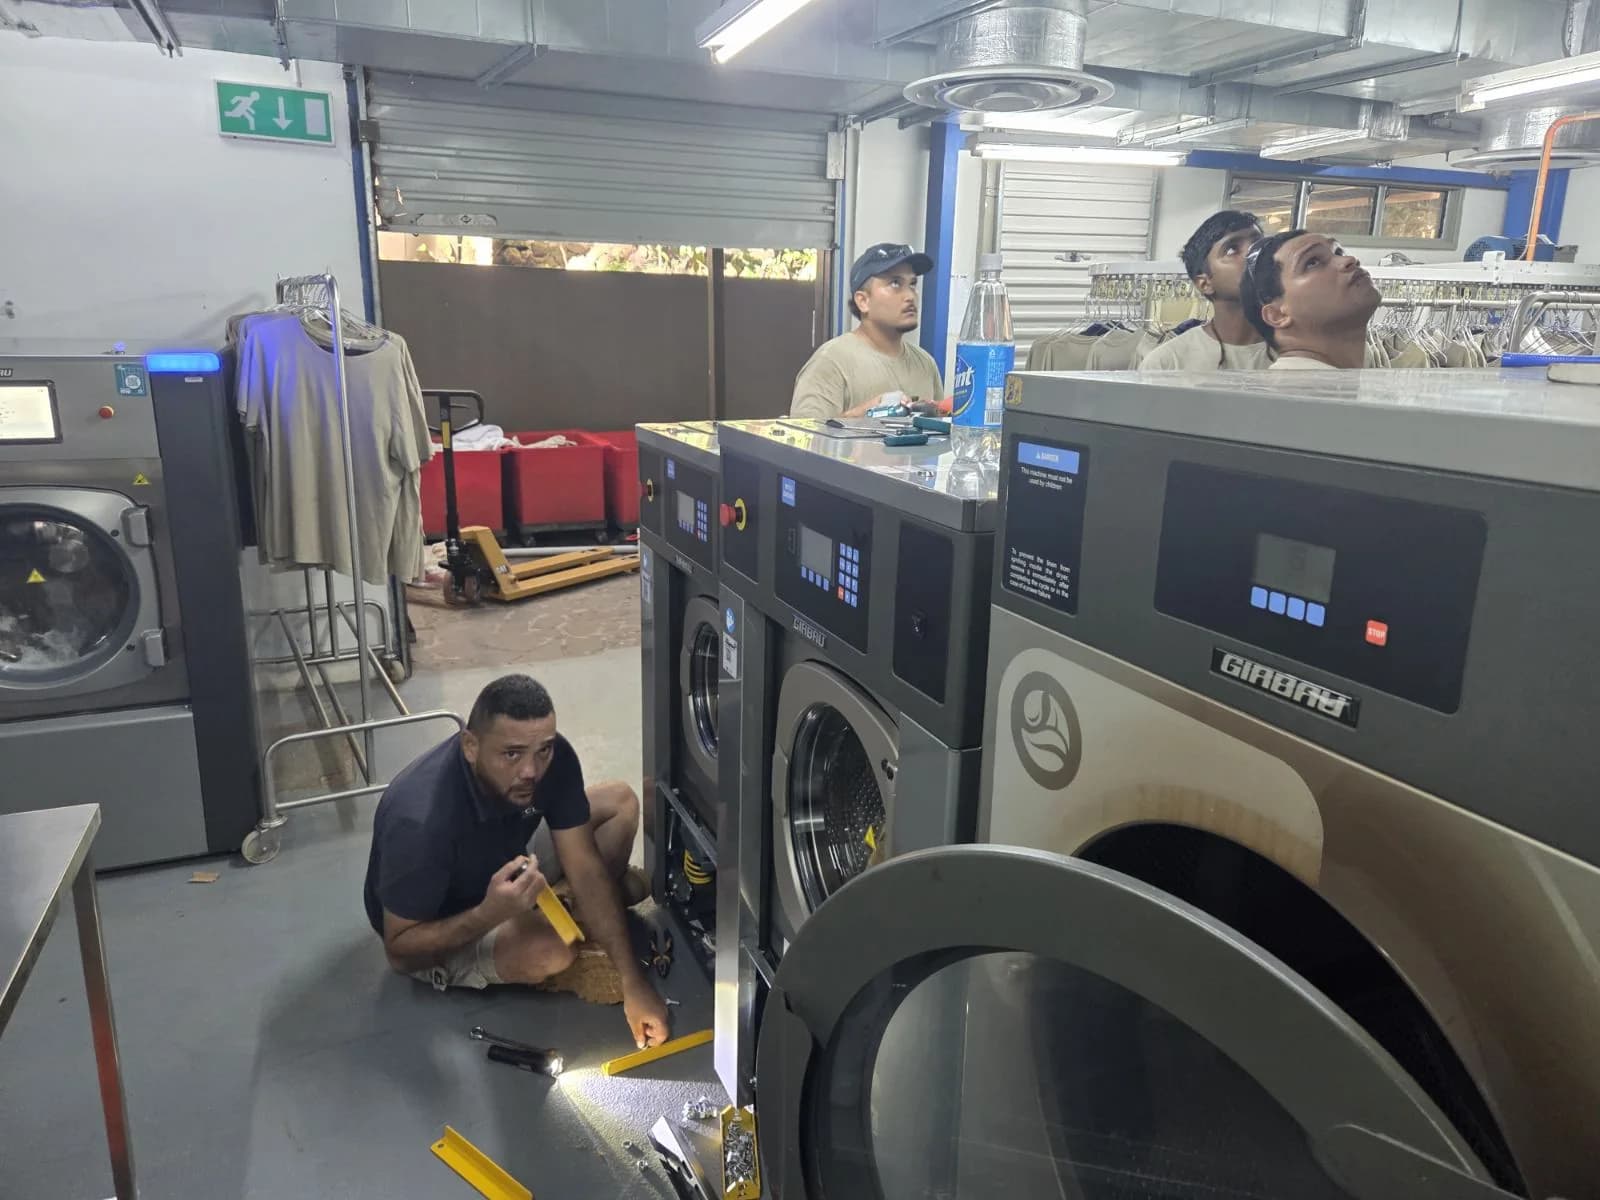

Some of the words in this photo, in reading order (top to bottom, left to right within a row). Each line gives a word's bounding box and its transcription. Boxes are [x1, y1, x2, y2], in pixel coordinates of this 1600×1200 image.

[1060, 564, 1071, 573] from
[793, 617, 825, 648] GIRBAU
[1367, 627, 1386, 640] STOP
[1220, 653, 1349, 718] GIRBAU
